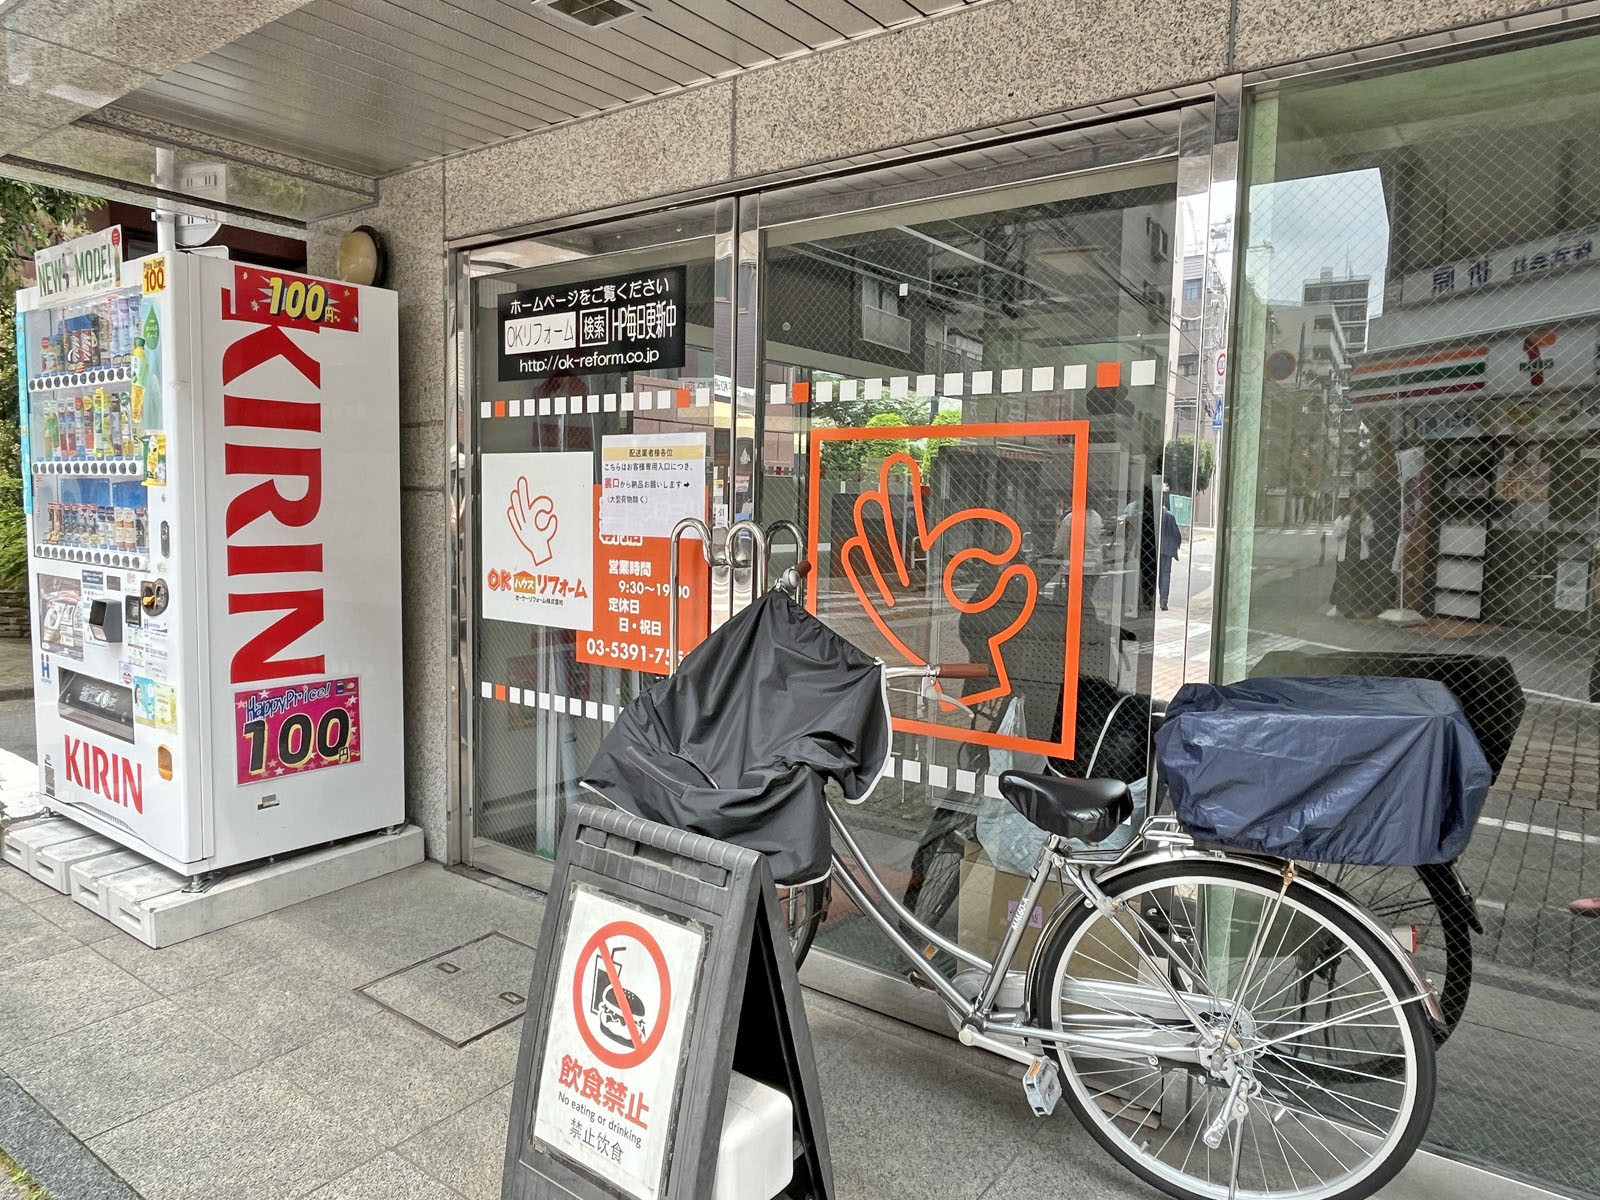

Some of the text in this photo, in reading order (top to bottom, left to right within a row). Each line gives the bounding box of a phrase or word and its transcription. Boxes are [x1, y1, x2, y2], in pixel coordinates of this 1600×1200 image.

[38, 259, 63, 297] NEW
[510, 277, 669, 315] ホームページをご覧ください
[507, 299, 677, 348] OKリフォーム 検索 HP毎日更新中
[519, 348, 660, 373] http://ok-reform.co.jp
[221, 287, 327, 684] KIRIN
[537, 574, 588, 599] リフォーム
[608, 559, 652, 577] 営業時間
[608, 597, 640, 615] 定休日
[618, 580, 690, 599] 9:30～190
[618, 617, 662, 637] 日・祝日
[64, 734, 143, 815] KIRIN
[558, 1054, 649, 1130] 飲食禁止
[558, 1090, 642, 1148] No eating or drinking
[569, 1117, 624, 1164] 禁止饮食
